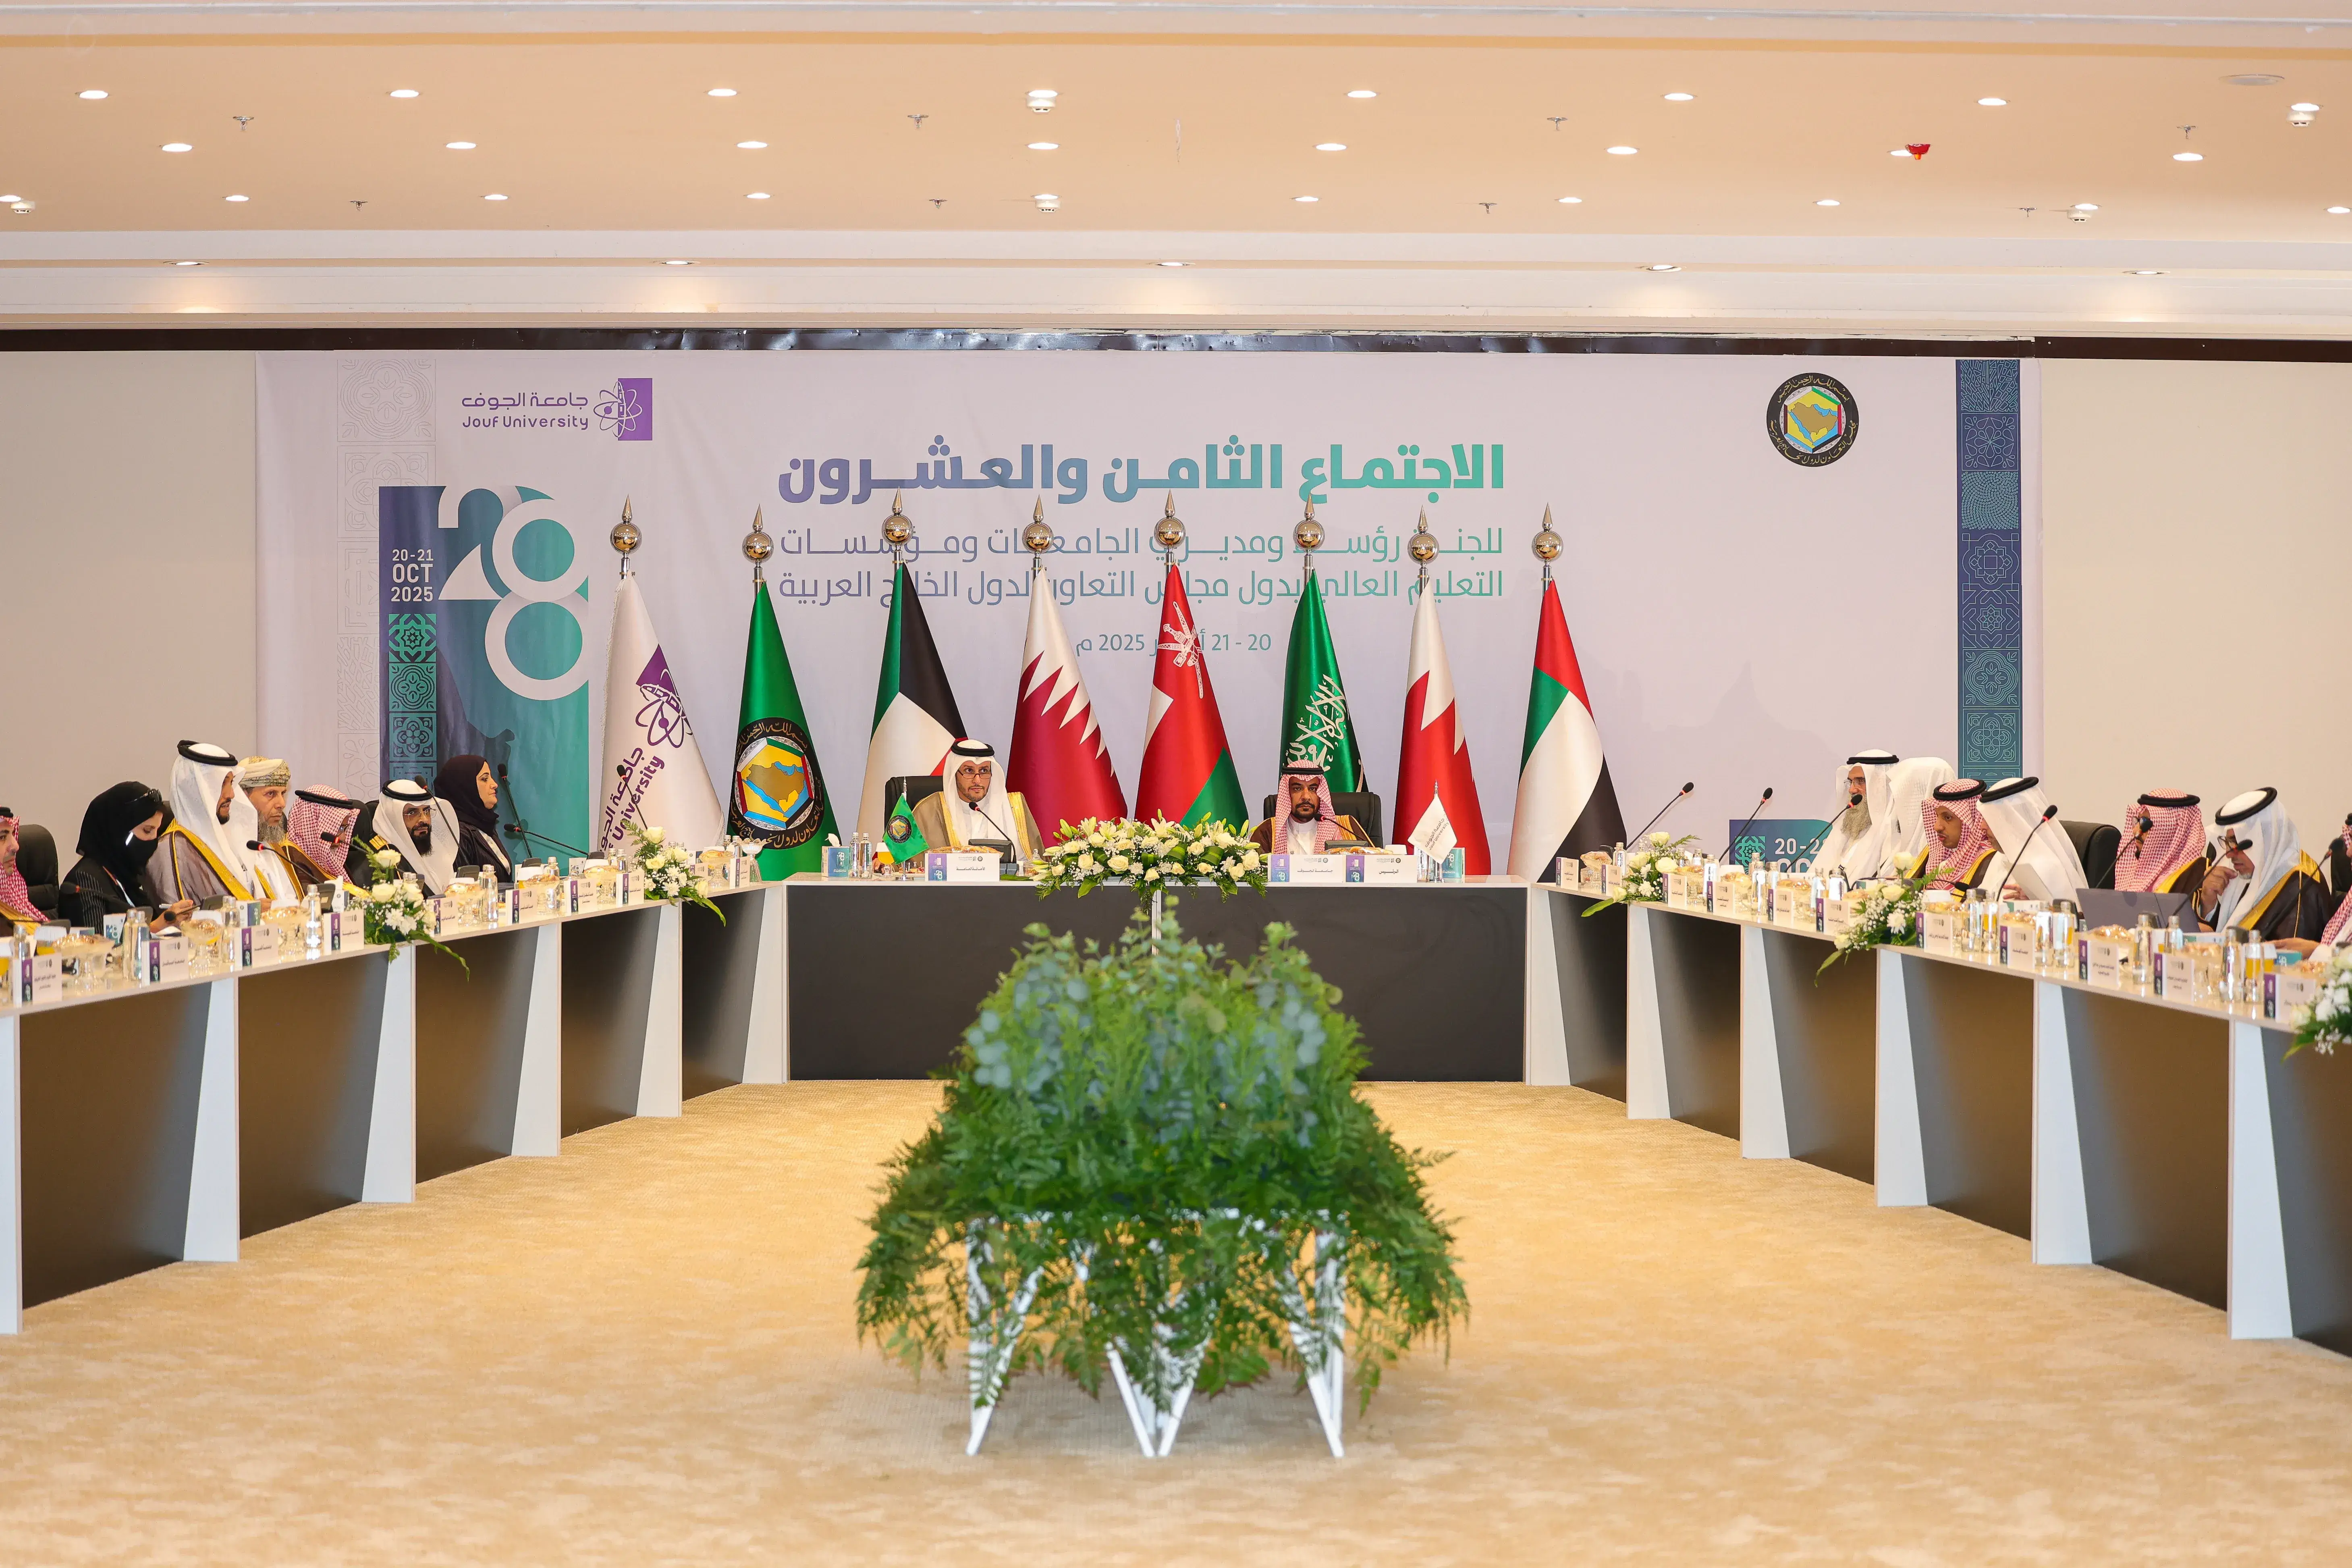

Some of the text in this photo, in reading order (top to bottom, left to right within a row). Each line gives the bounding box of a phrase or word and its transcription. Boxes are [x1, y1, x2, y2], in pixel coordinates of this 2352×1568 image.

[462, 392, 589, 411] جامعة الجوف
[463, 415, 589, 431] Jouf University
[779, 435, 1504, 505] الاجتماع الثامن والعشرون
[1414, 528, 1503, 561] للجن
[392, 549, 434, 561] 20-21
[393, 564, 434, 584] OCT
[391, 587, 434, 602] 2025
[438, 485, 589, 700] 28
[780, 571, 871, 606] العربية
[1099, 634, 1145, 651] 2025
[1212, 634, 1229, 651] 21
[1248, 634, 1272, 651] 20
[1775, 838, 1826, 855] 20-2
